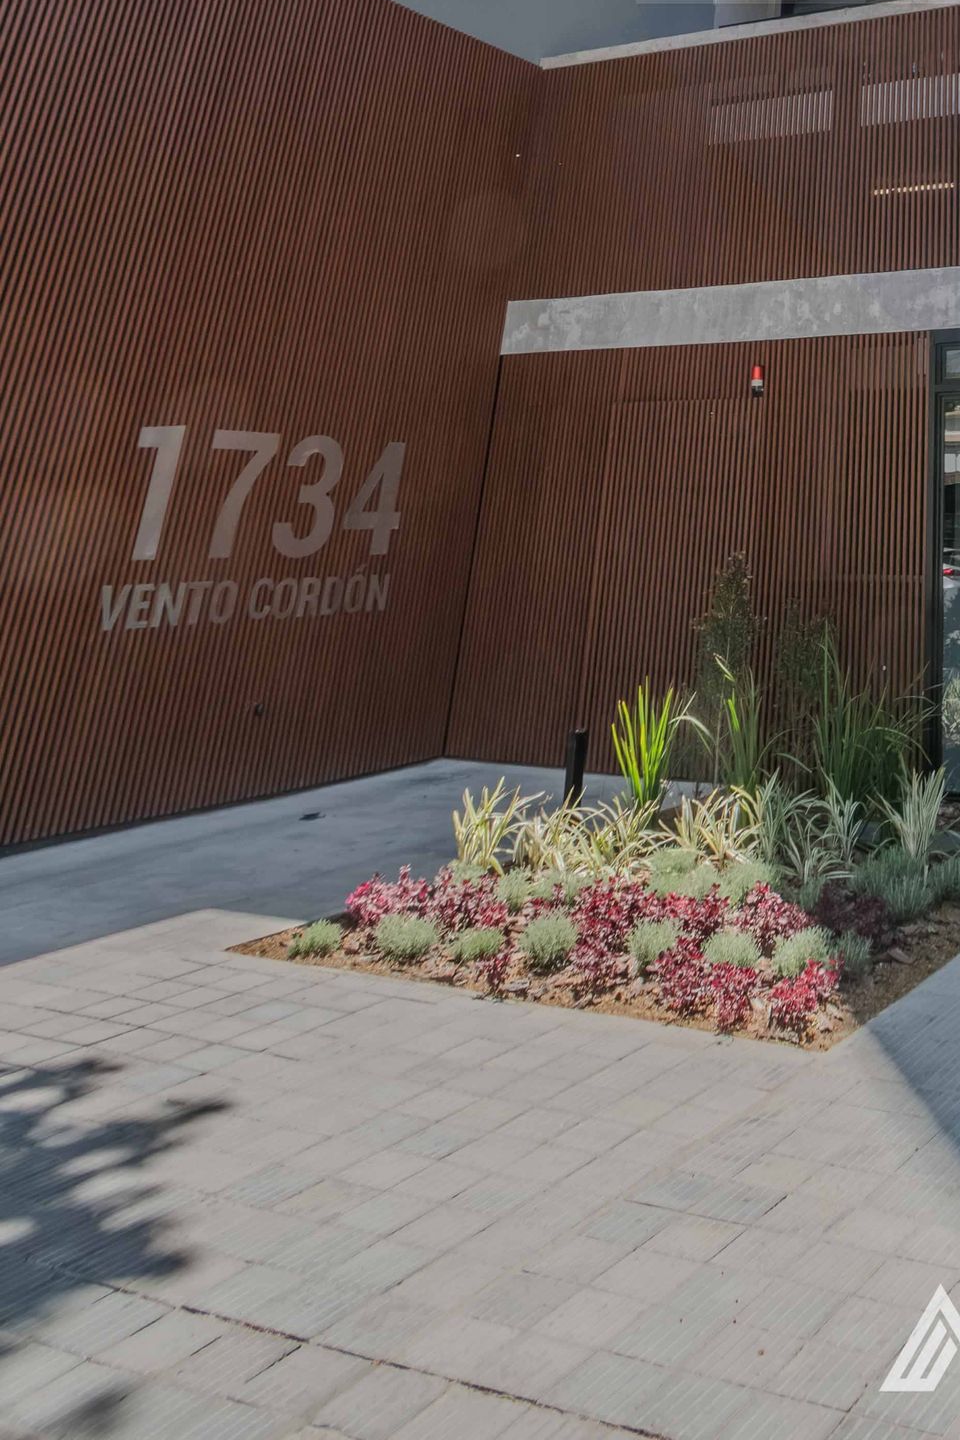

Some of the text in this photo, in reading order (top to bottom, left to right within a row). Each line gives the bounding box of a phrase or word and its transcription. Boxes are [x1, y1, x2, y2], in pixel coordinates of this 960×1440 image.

[131, 425, 406, 560] 1734
[101, 564, 391, 631] VENTO CORDÓN
